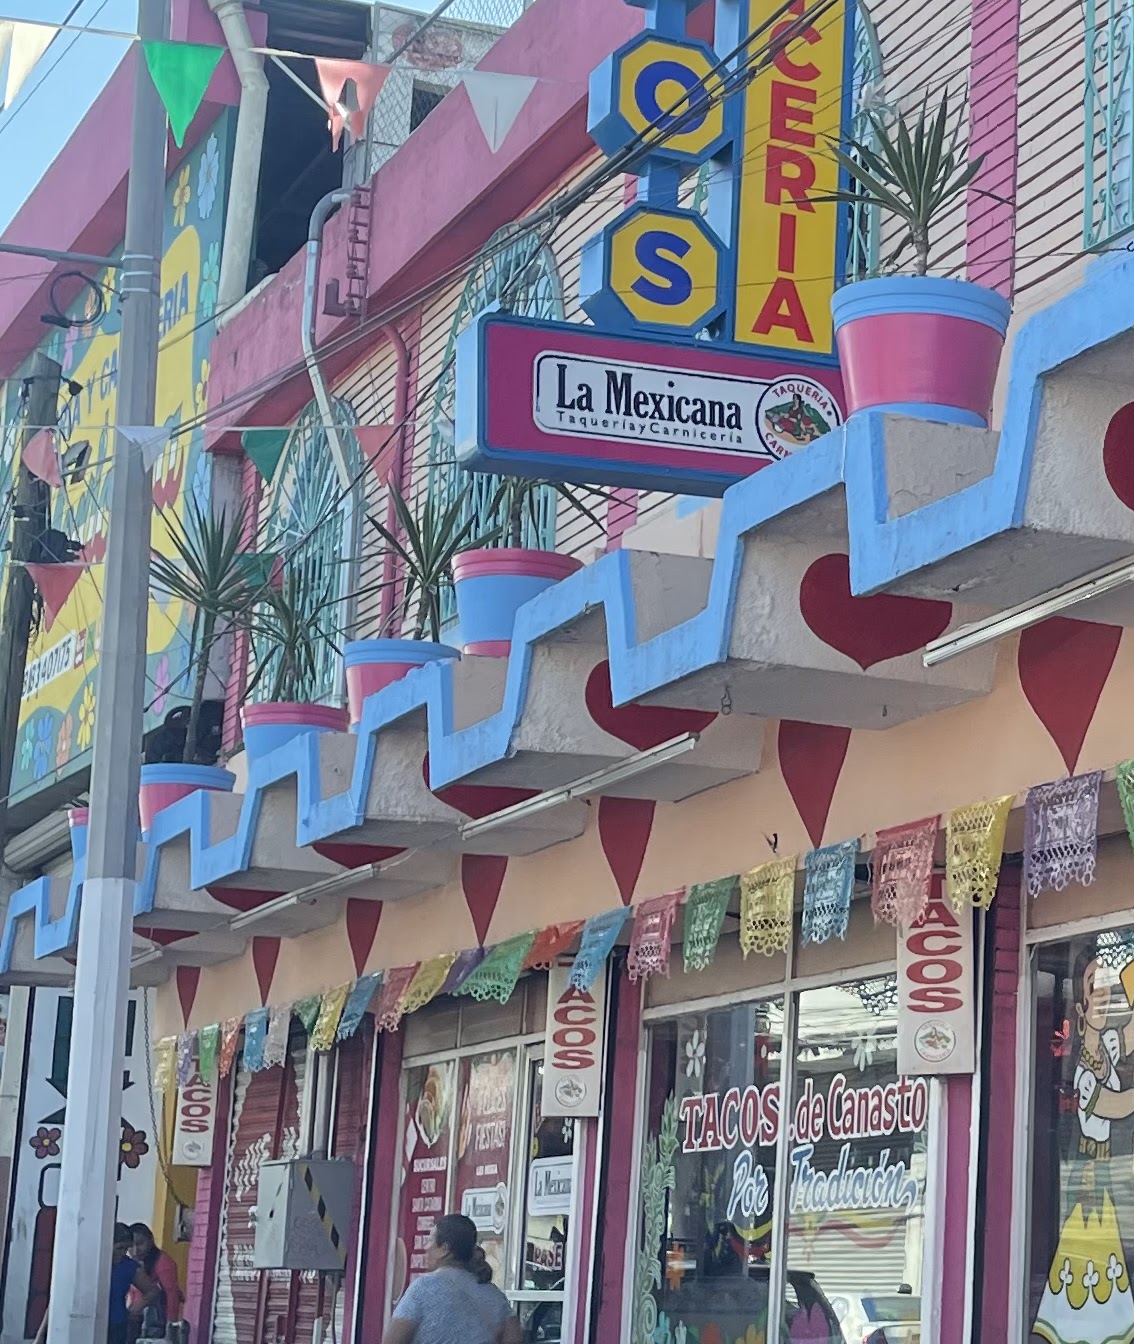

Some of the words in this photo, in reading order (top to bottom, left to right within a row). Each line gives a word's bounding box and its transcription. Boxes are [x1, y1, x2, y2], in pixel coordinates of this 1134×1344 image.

[556, 364, 593, 413] La
[605, 370, 743, 430] Mexicana
[679, 1082, 780, 1153] TACOS
[827, 1073, 928, 1140] Canasto
[727, 1150, 769, 1220] Por
